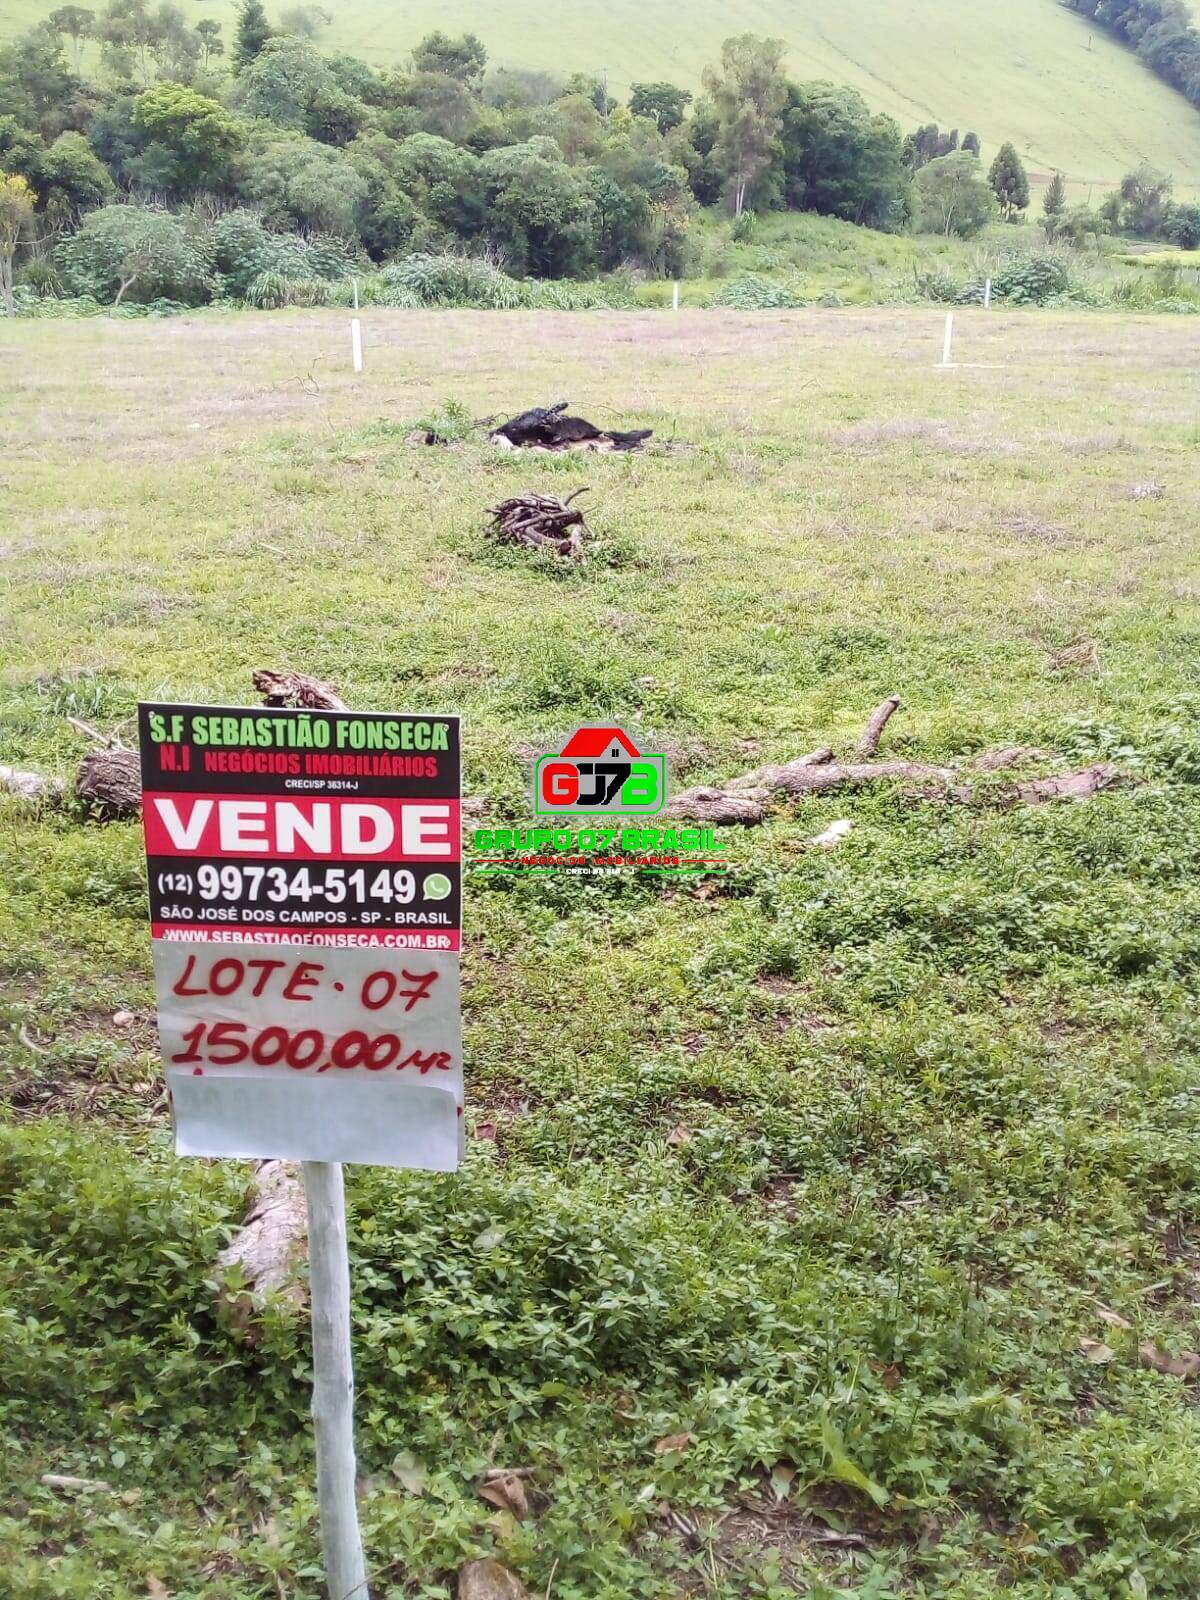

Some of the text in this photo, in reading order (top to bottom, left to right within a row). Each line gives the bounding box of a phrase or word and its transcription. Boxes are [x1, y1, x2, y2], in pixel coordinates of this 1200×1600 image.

[150, 714, 449, 750] S.F SEBASTIÃO FONSECA
[160, 744, 439, 778] N.I NEGÓCIOS IMOBILIÁRIOS
[285, 779, 326, 789] CRECI/SP
[153, 798, 451, 855] VENDE
[157, 865, 417, 904] (12) 99734-5149
[160, 906, 193, 920] SÃO
[197, 906, 238, 922] JOSÉ
[242, 909, 275, 922] DOS
[279, 910, 346, 924] CAMPOS
[361, 911, 381, 924] SP
[395, 911, 452, 925] BRASIL
[361, 970, 439, 1012] 07
